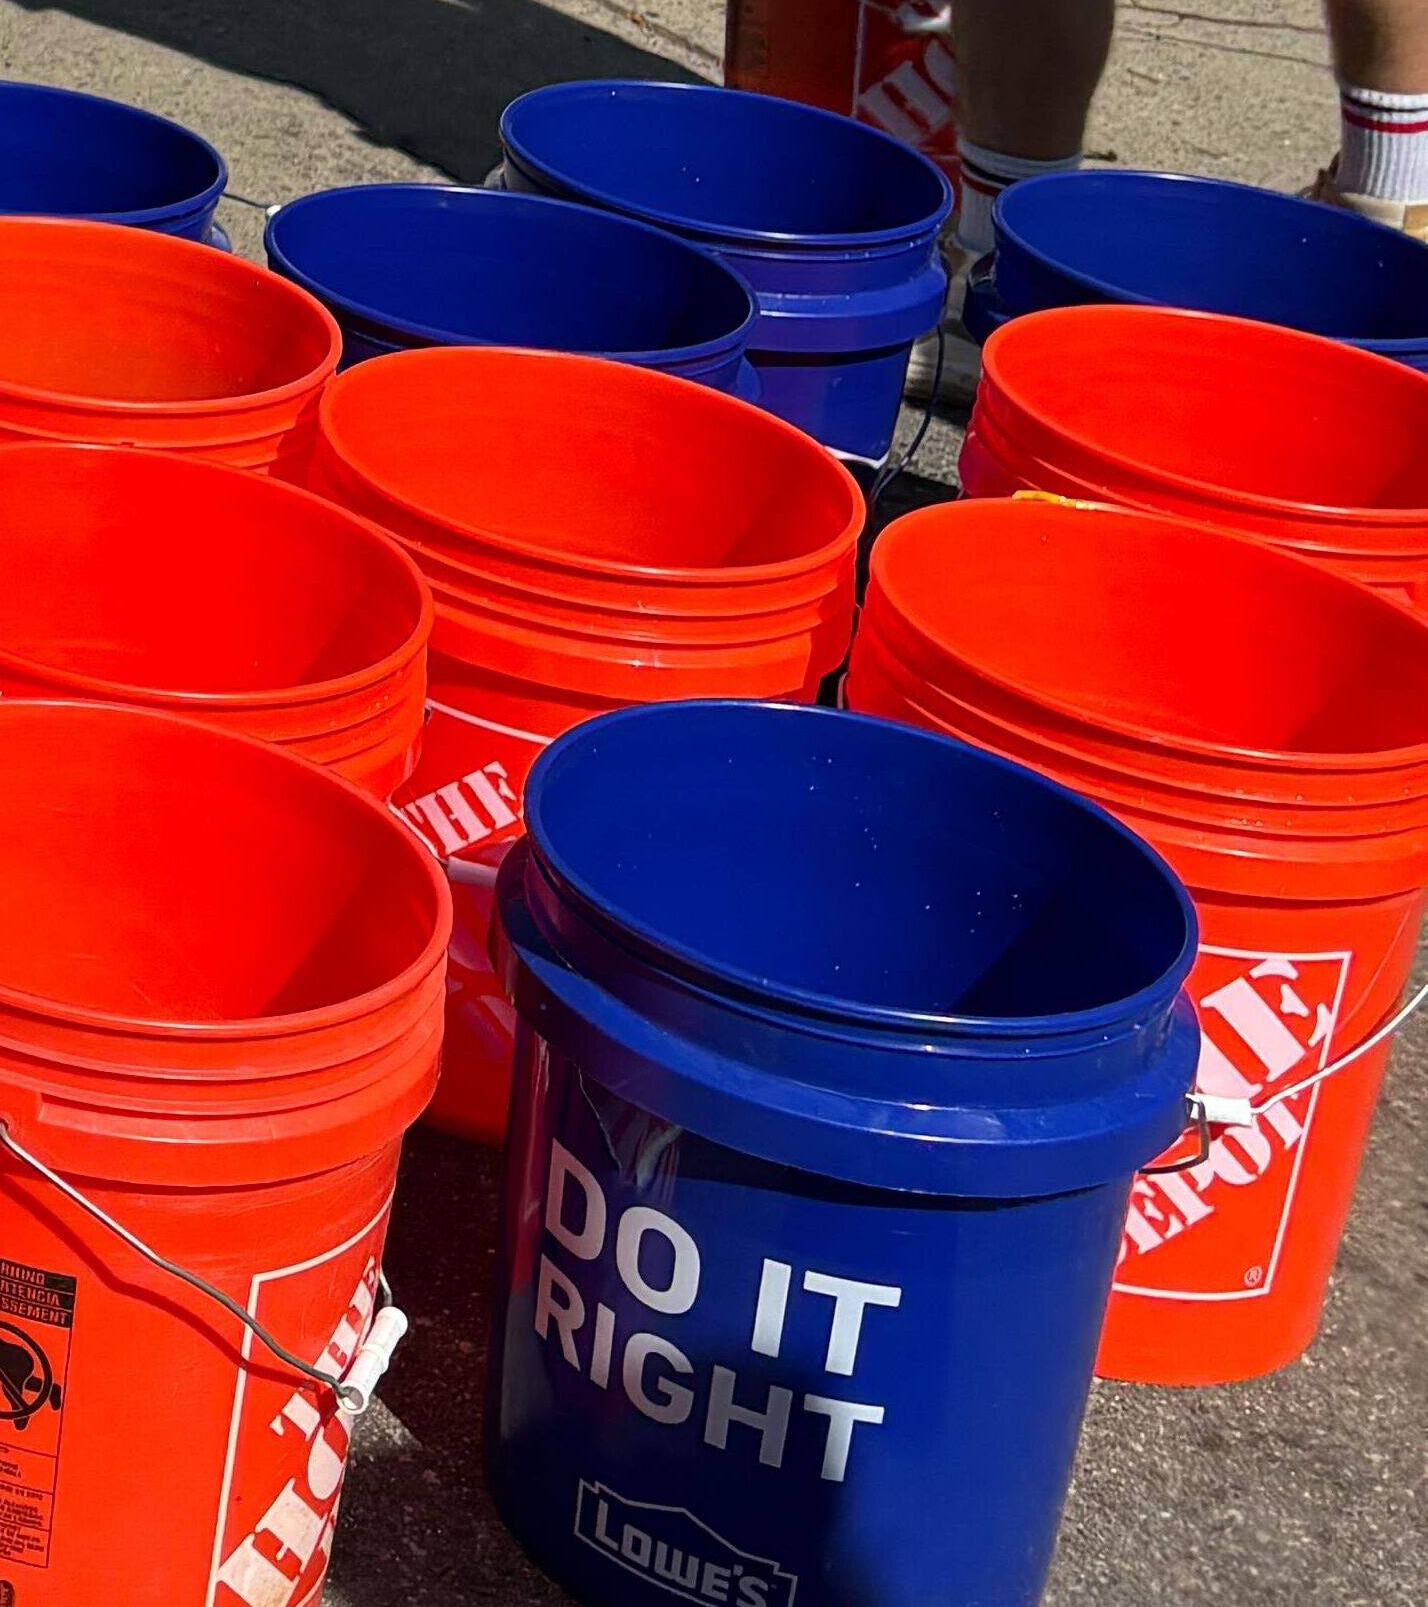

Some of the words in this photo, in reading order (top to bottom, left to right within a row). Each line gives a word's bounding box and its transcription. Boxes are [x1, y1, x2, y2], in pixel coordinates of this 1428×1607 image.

[534, 1252, 885, 1483] RIGHT
[545, 1137, 701, 1315] DO
[751, 1258, 902, 1377] IT
[594, 1499, 770, 1607] LOWE'S
